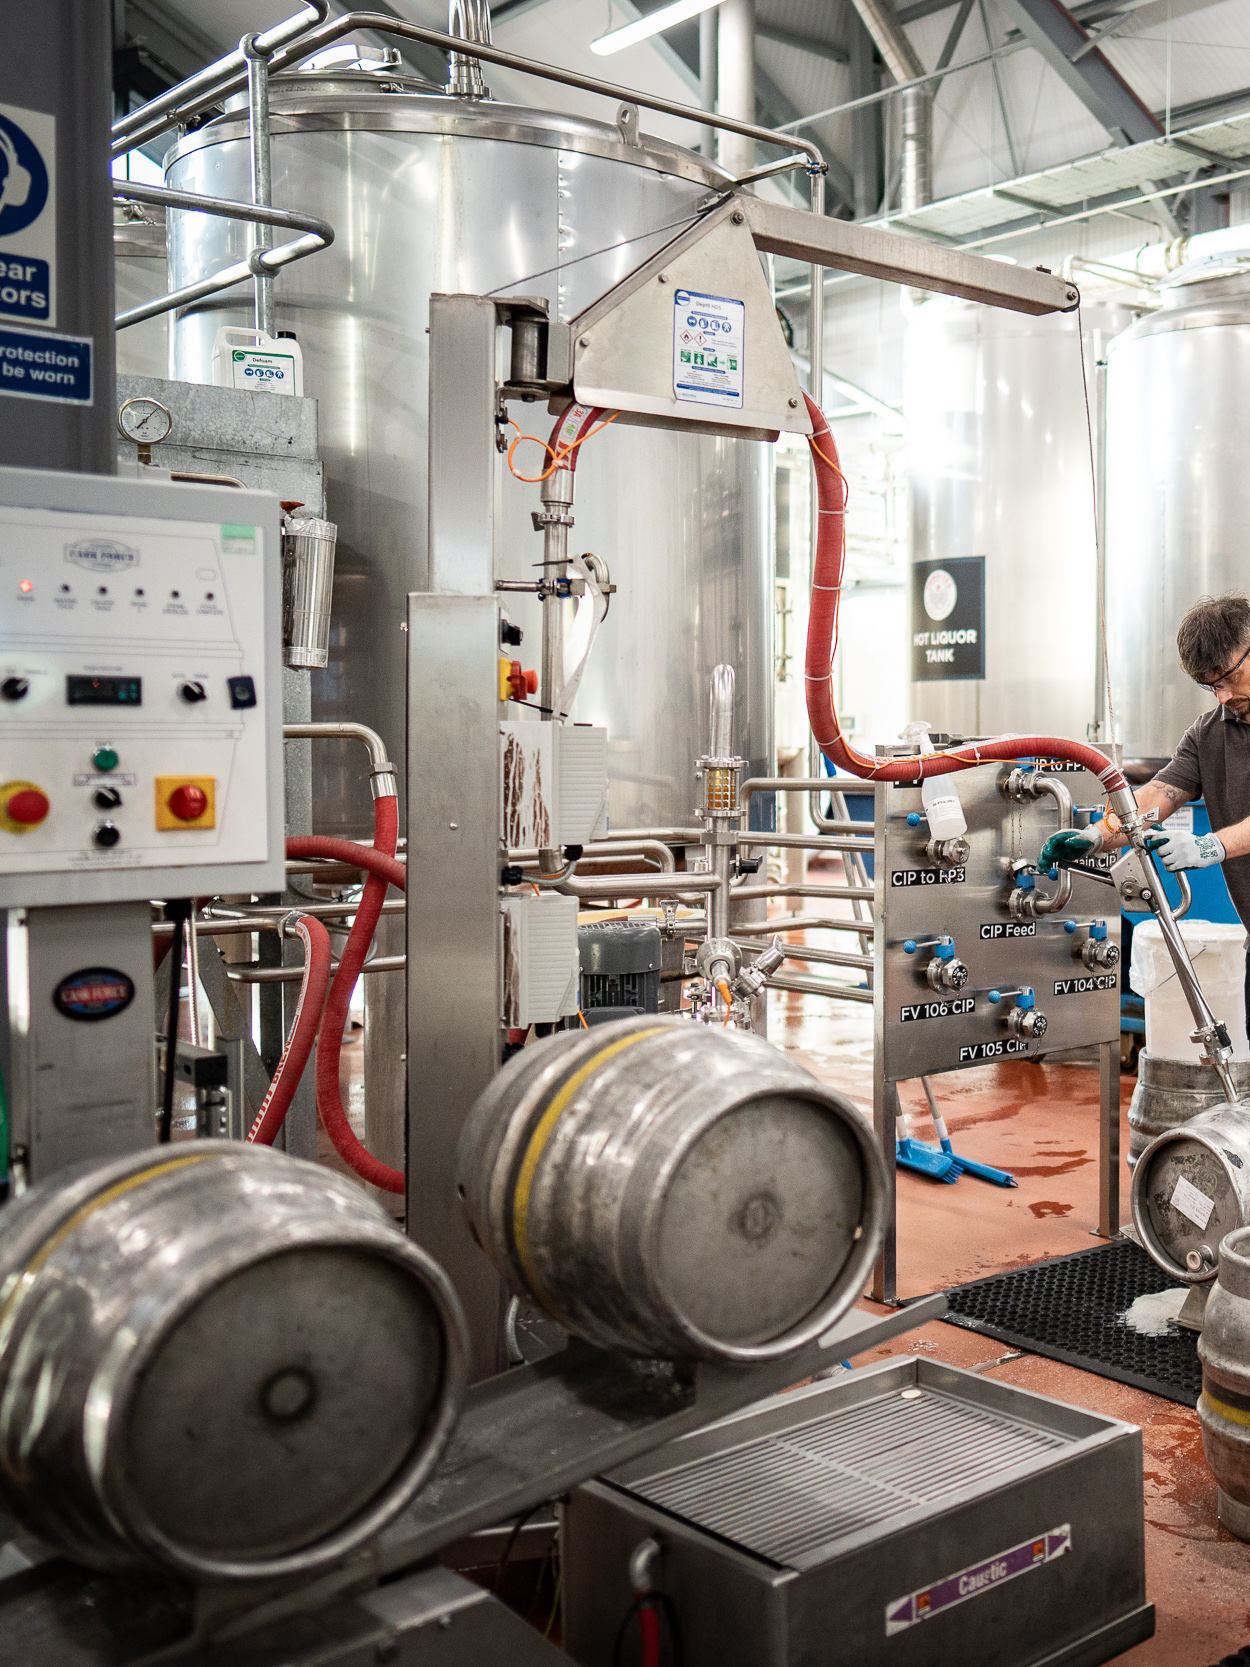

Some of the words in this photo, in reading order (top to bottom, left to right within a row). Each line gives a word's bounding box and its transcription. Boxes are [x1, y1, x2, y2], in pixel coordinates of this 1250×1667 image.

[0, 286, 47, 309] ors
[2, 361, 25, 378] be
[29, 368, 75, 385] worn
[913, 632, 930, 647] HOT
[931, 629, 977, 645] LIQUOR
[925, 648, 955, 663] TANK
[1036, 758, 1047, 771] IP
[892, 871, 916, 886] CIP
[921, 871, 935, 884] to
[981, 924, 1002, 939] CIP
[1006, 922, 1036, 937] Feed
[1054, 981, 1071, 995] FV
[1074, 979, 1093, 993] 104
[1097, 975, 1116, 989] CIP
[901, 1006, 921, 1021] FV
[924, 1003, 948, 1018] 106
[952, 999, 975, 1014] CIP
[960, 1045, 978, 1061] FV
[981, 1042, 1003, 1057] 105
[958, 1561, 1008, 1595] Caustic
